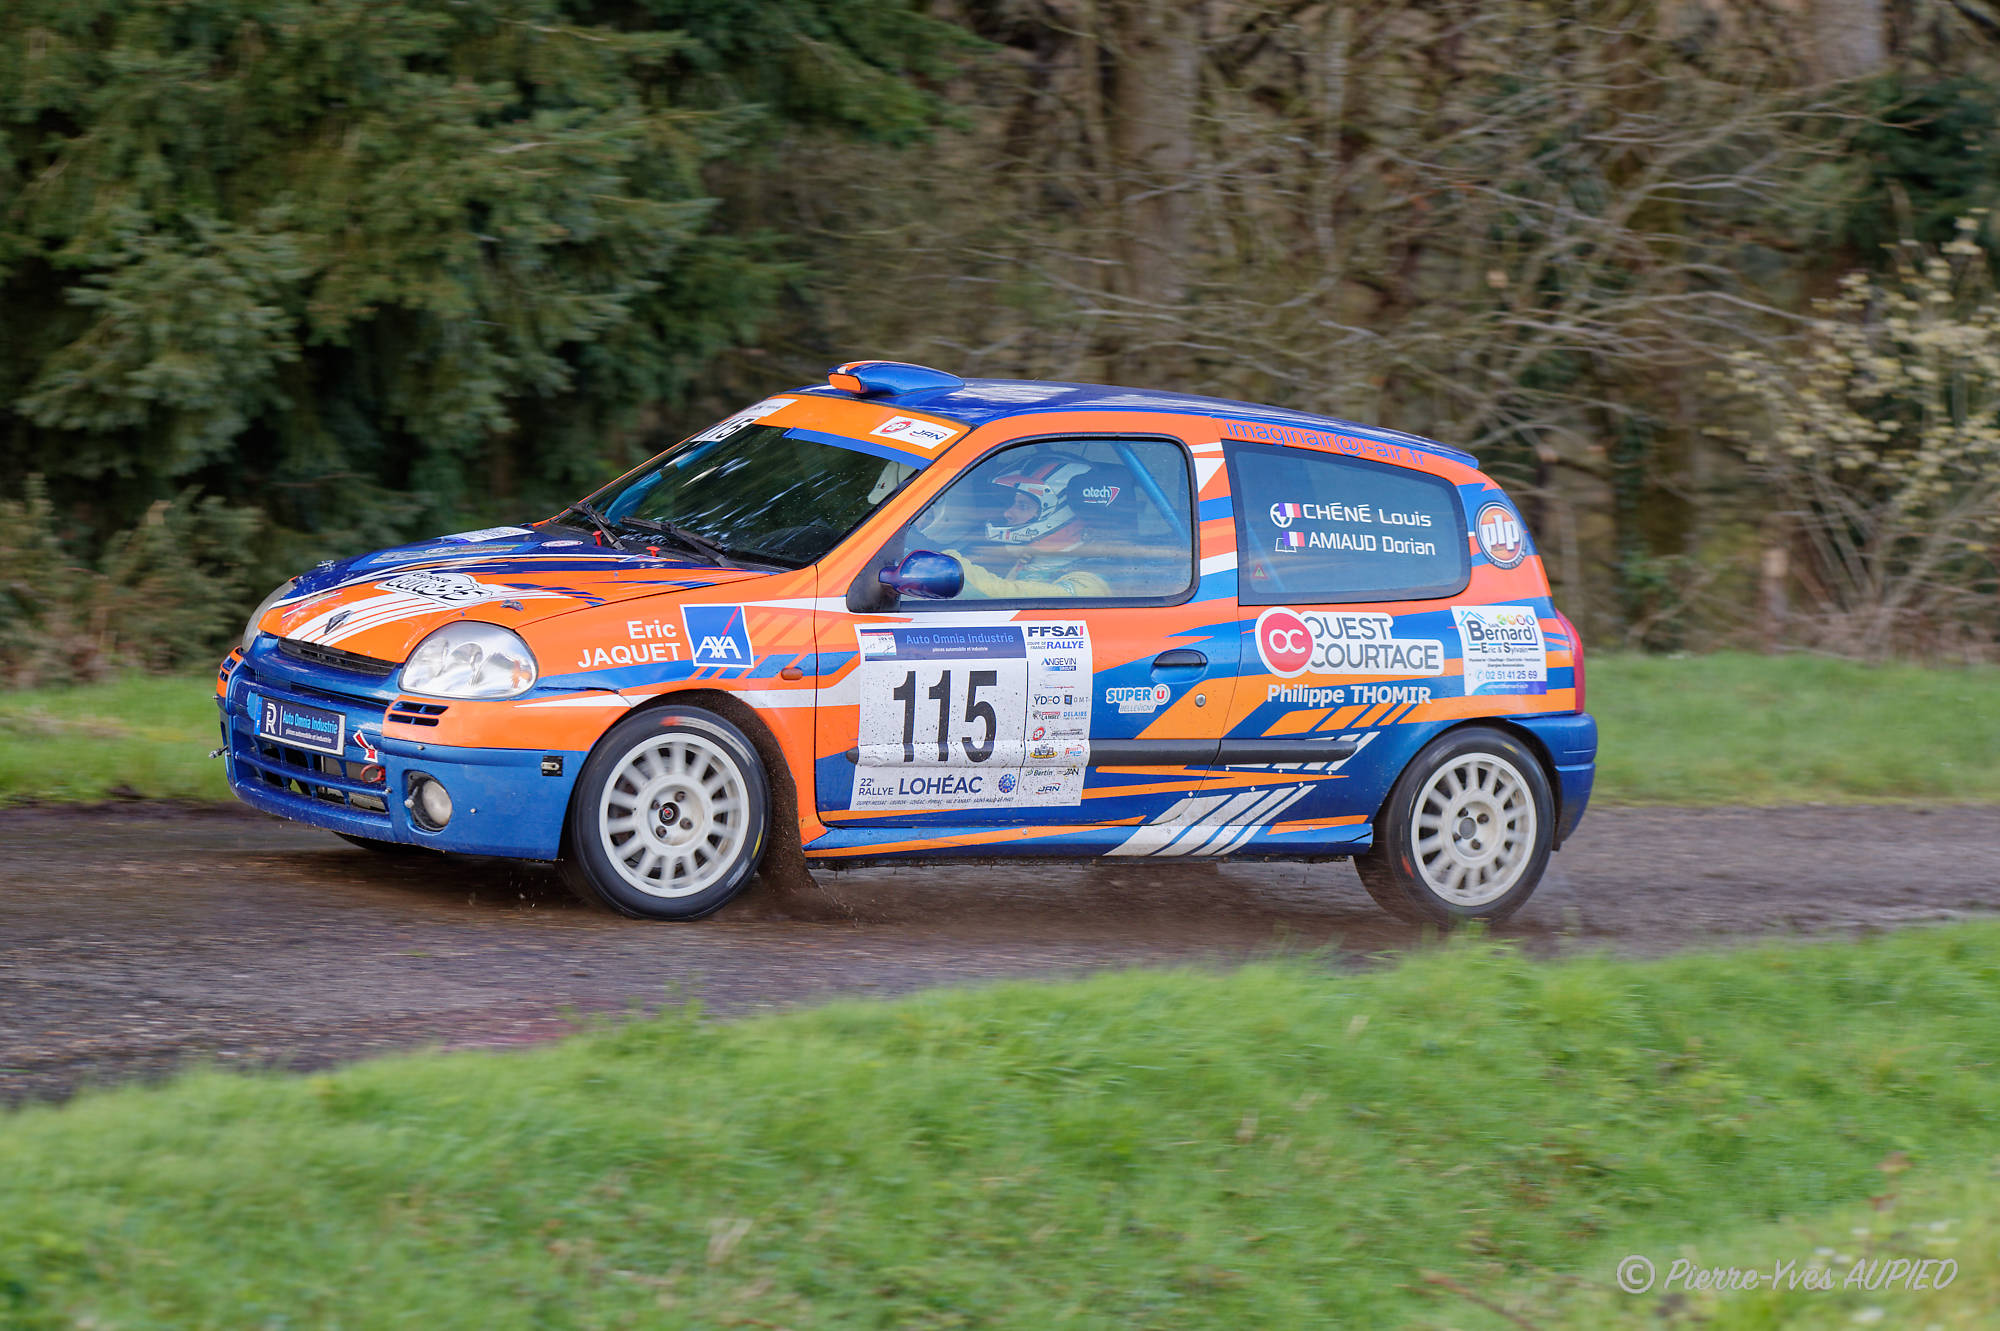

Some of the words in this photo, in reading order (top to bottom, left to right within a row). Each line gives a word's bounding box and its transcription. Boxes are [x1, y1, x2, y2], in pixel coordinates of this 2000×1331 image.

[1302, 502, 1372, 523] CHÉNÉ
[1378, 508, 1432, 527] Louis
[1308, 531, 1377, 552] AMIAUD
[1382, 535, 1436, 556] Dorian
[627, 620, 677, 640] Eric
[906, 634, 930, 645] Auto
[933, 633, 965, 644] Omnia
[968, 632, 1014, 643] Industrie
[1028, 626, 1079, 637] FFSA
[1304, 616, 1388, 640] OUEST
[1466, 620, 1533, 641] Bernard
[577, 643, 681, 668] JAQUET
[695, 636, 742, 659] AXA
[1046, 641, 1084, 649] RALLYE
[1310, 643, 1440, 670] COURTAGE
[1107, 688, 1151, 702] SUPER
[1267, 684, 1345, 708] Philippe
[1350, 686, 1432, 705] THOMIR
[283, 710, 294, 726] Auto
[312, 716, 338, 735] Industrie
[893, 669, 997, 763] 115
[858, 787, 894, 796] RALLYE
[899, 774, 983, 795] LOHÉAC
